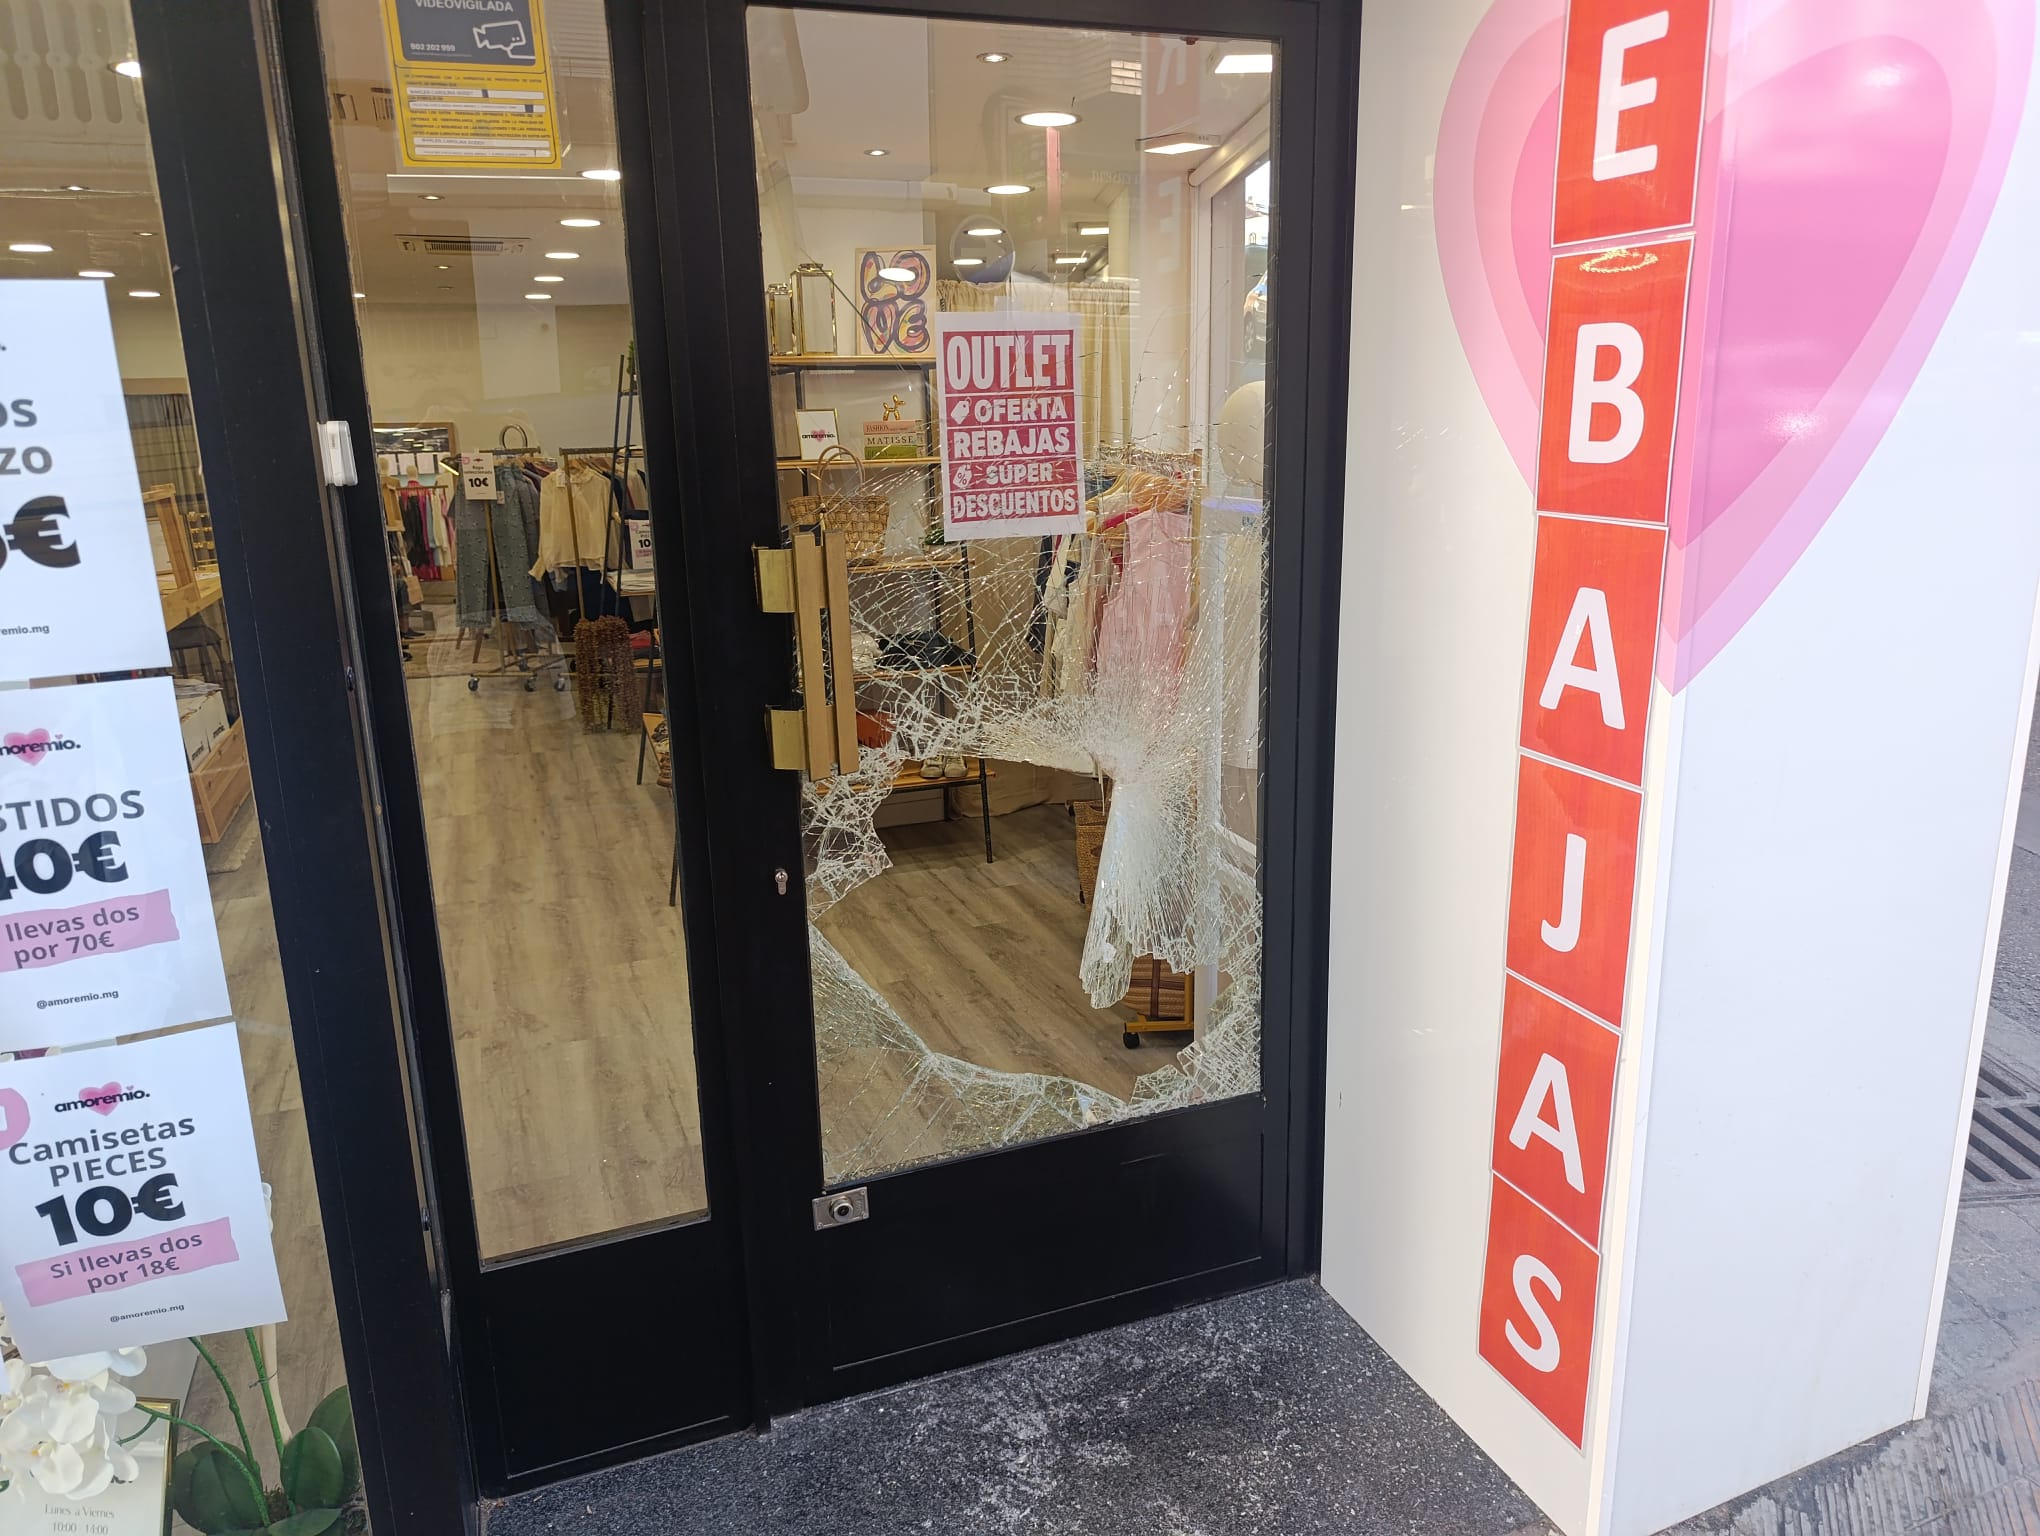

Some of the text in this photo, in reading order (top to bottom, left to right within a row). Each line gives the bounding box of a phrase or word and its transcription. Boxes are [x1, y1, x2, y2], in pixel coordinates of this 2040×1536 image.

[415, 0, 514, 12] VIDEOVIGILADA
[947, 334, 1070, 391] OUTLET
[0, 398, 38, 428] S
[974, 396, 1067, 424] OFERTA
[867, 435, 914, 445] MATISSE
[953, 426, 1070, 458] REBAJAS
[468, 477, 489, 488] 10€
[953, 488, 1076, 519] DESCUENTOS
[5, 906, 140, 942] llevas dos
[14, 930, 115, 969] por 70€
[36, 990, 119, 1010] @amoremio.mg
[9, 1117, 196, 1166] Camisetas
[49, 1147, 167, 1188] PIECES
[35, 1172, 187, 1247] 10€
[51, 1233, 203, 1279] Si llevas dos
[87, 1256, 180, 1293] por 18€
[110, 1303, 185, 1323] @amoremio.mg
